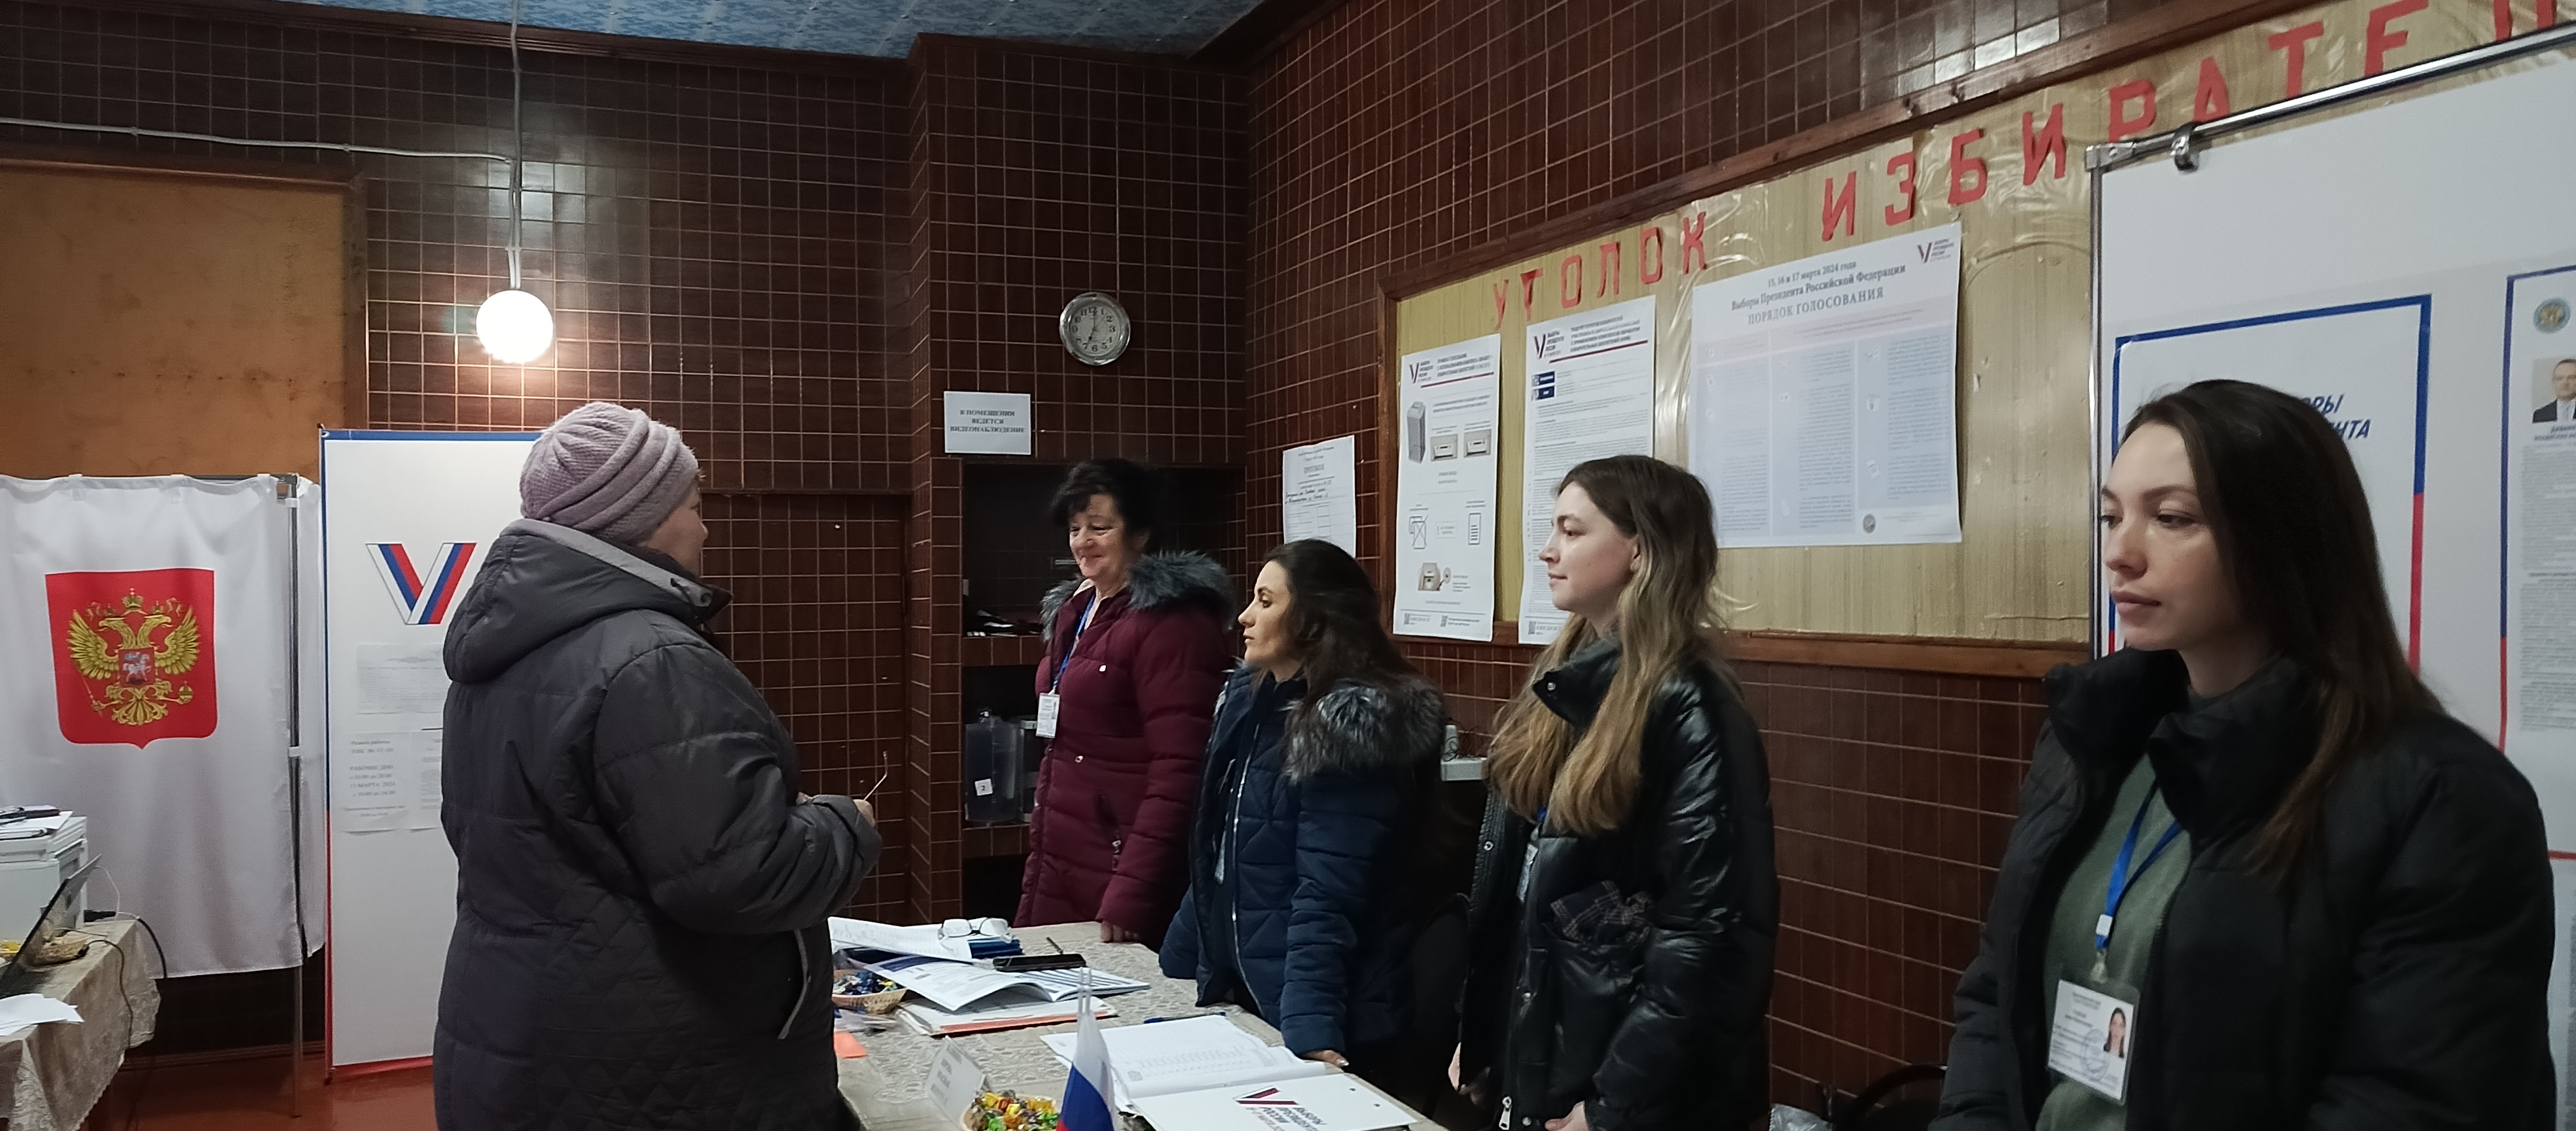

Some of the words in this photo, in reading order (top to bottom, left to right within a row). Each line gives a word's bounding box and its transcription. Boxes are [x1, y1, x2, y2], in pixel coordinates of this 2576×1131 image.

[1493, 211, 1707, 331] УГОЛОК
[1731, 296, 1760, 311] Выборы
[1761, 287, 1804, 306] Президента
[1805, 274, 1855, 295] Российской
[1856, 264, 1906, 284] Федерации
[1748, 304, 1794, 325] ПОРЯДОК
[1796, 287, 1884, 315] ГОЛОСОВАНИЯ
